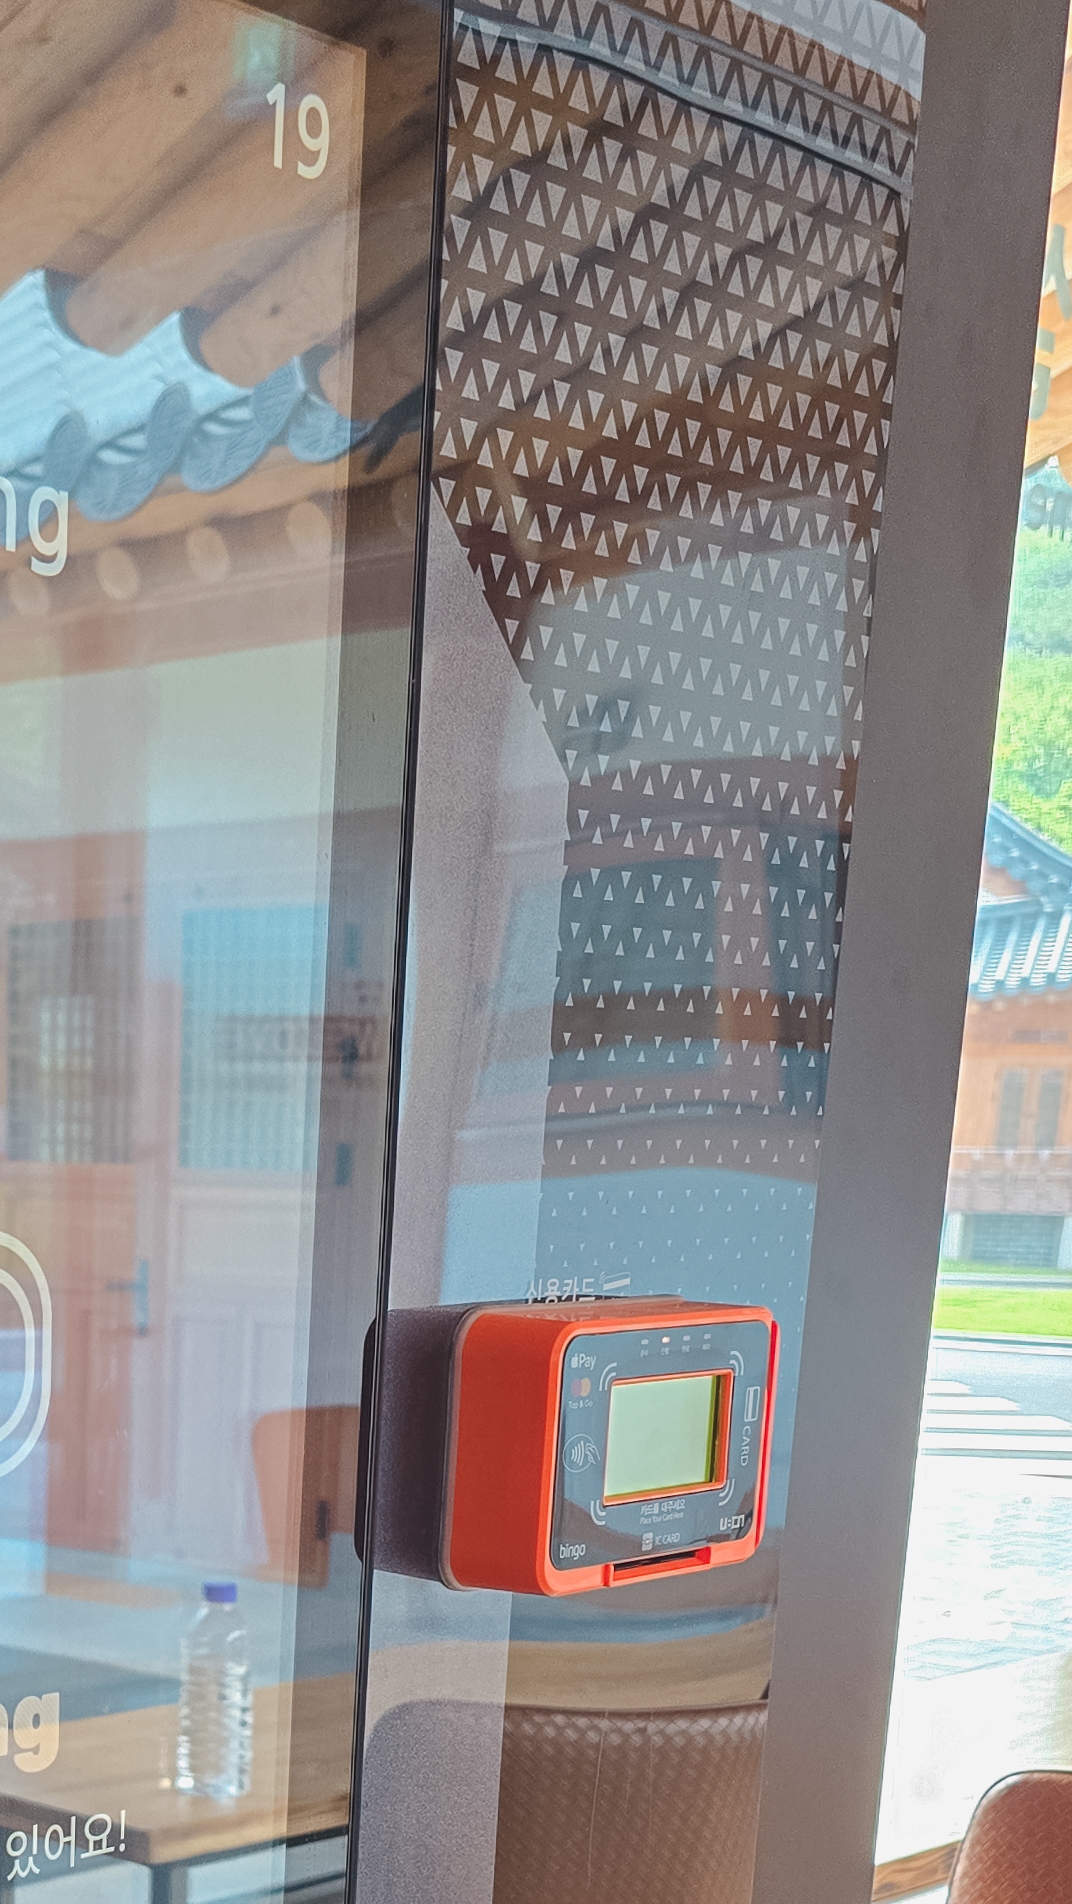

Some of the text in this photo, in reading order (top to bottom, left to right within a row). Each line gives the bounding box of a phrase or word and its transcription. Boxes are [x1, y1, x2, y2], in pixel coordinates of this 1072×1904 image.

[266, 82, 330, 180] 19
[578, 1353, 597, 1371] Pay
[740, 1425, 751, 1466] CARD
[559, 1543, 586, 1560] bingo
[4, 1808, 128, 1881] 있어요!
